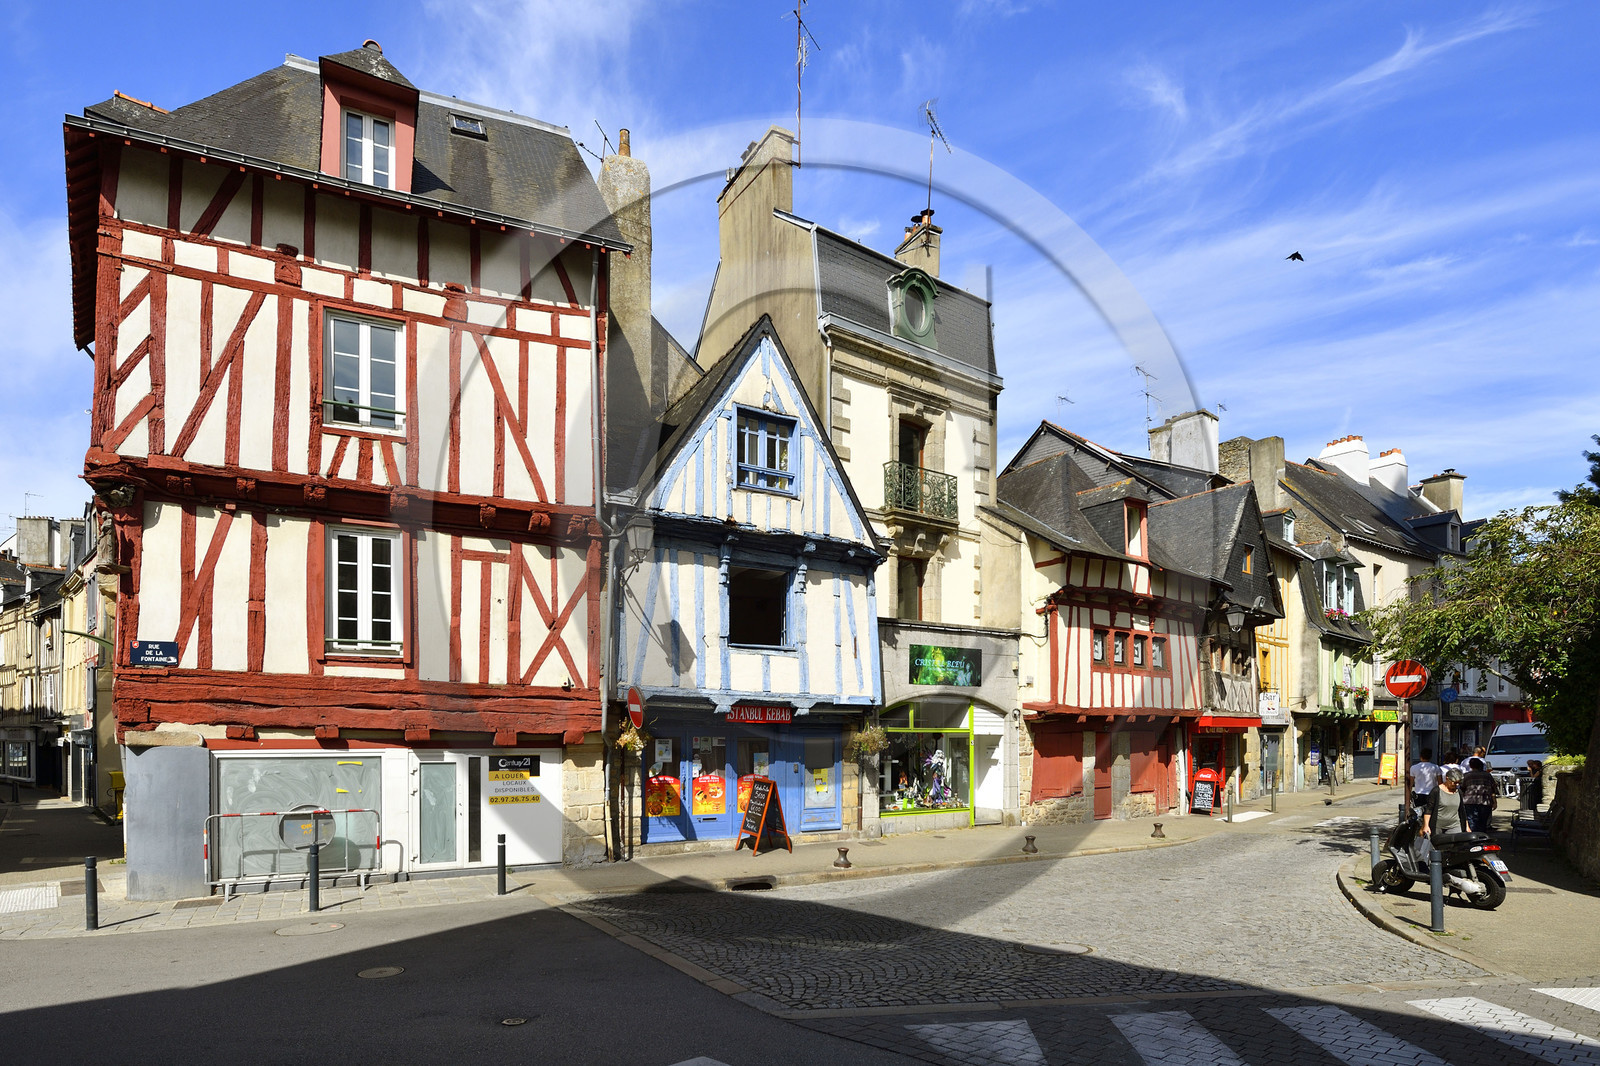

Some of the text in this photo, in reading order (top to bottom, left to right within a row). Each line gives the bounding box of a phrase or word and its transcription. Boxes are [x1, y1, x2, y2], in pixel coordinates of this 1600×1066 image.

[946, 660, 965, 668] BLEU
[1263, 693, 1276, 701] Bar
[766, 708, 791, 721] KEBAB
